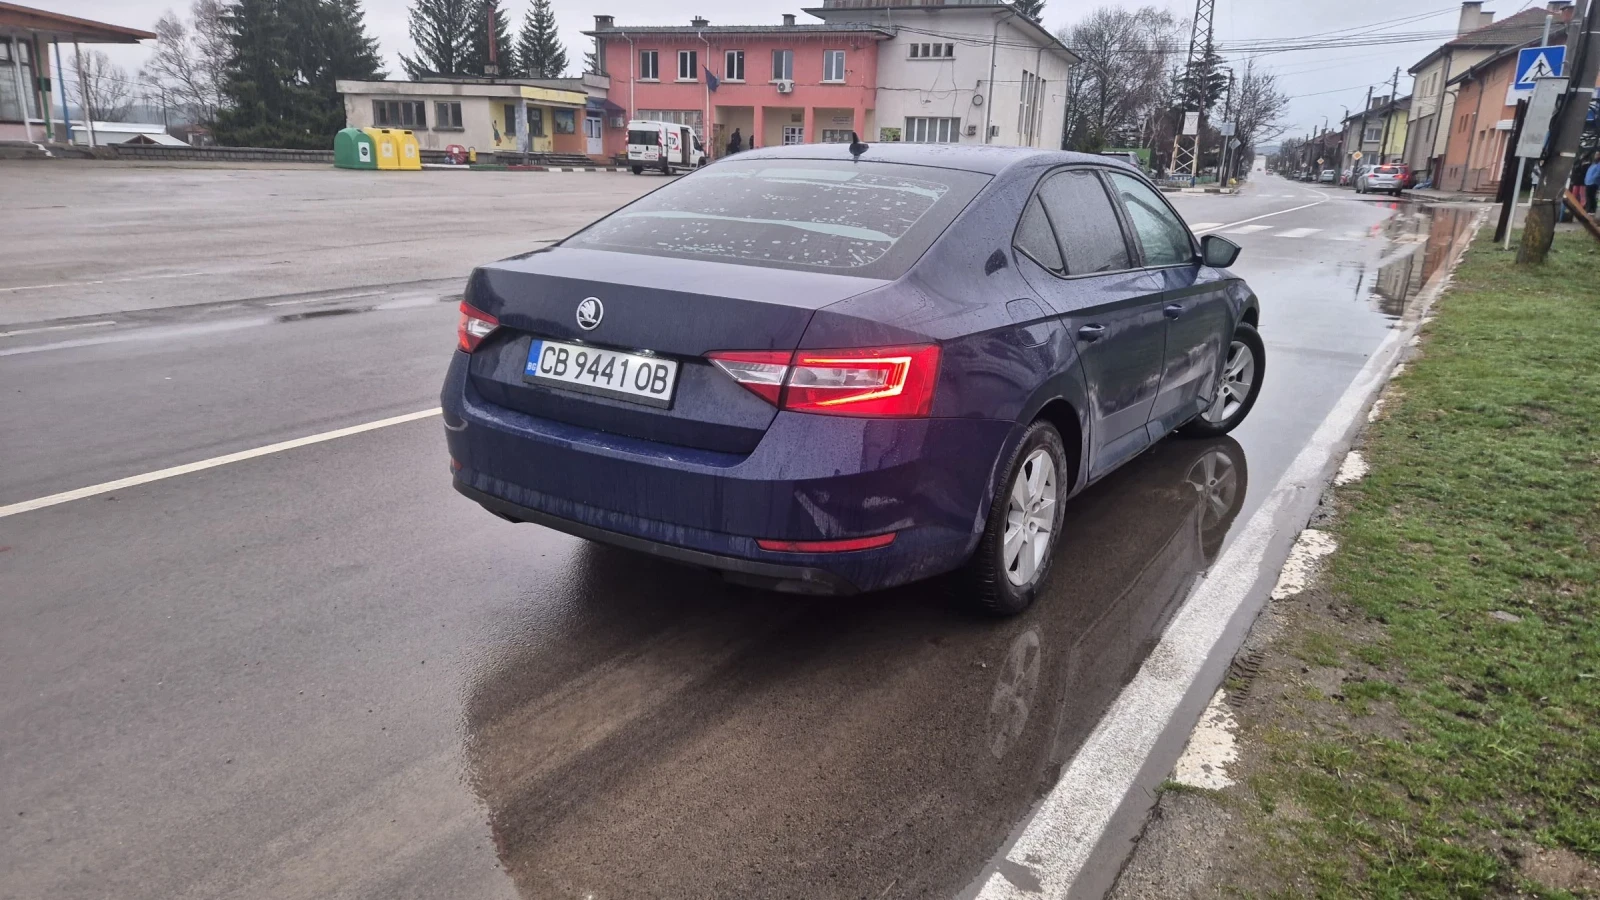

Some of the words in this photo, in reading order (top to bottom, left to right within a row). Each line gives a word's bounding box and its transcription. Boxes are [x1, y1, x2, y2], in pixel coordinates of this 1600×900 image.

[527, 362, 537, 371] BG
[540, 346, 570, 376] CB
[574, 351, 630, 388] 9441
[634, 362, 669, 394] OB
